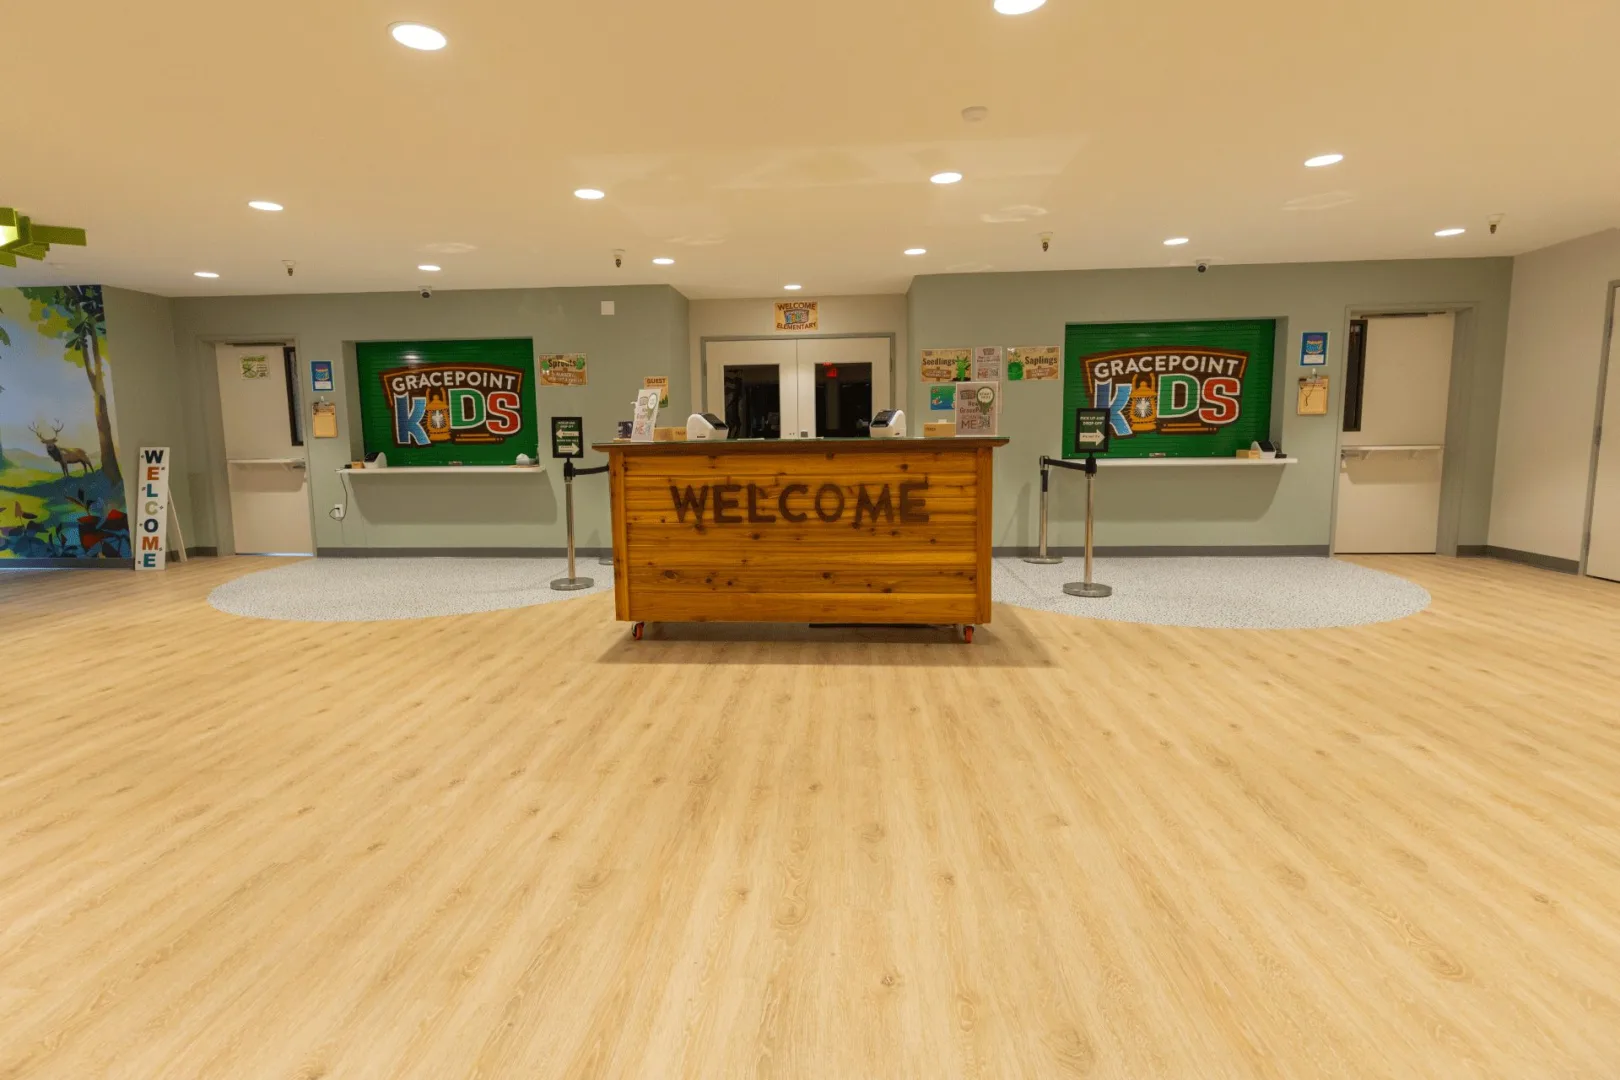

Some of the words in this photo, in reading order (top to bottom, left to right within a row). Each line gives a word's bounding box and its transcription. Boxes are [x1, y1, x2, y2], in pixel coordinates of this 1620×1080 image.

[777, 302, 816, 311] WELCOME
[776, 322, 817, 331] ELEMENTARY
[922, 357, 956, 367] Seedlings
[1024, 355, 1058, 366] Saplings
[1094, 355, 1239, 378] GRACEPOINT
[391, 371, 516, 392] GRACEPOINT
[961, 420, 977, 430] ME
[669, 483, 930, 523] WELCOME
[143, 450, 164, 568] WELCOME
